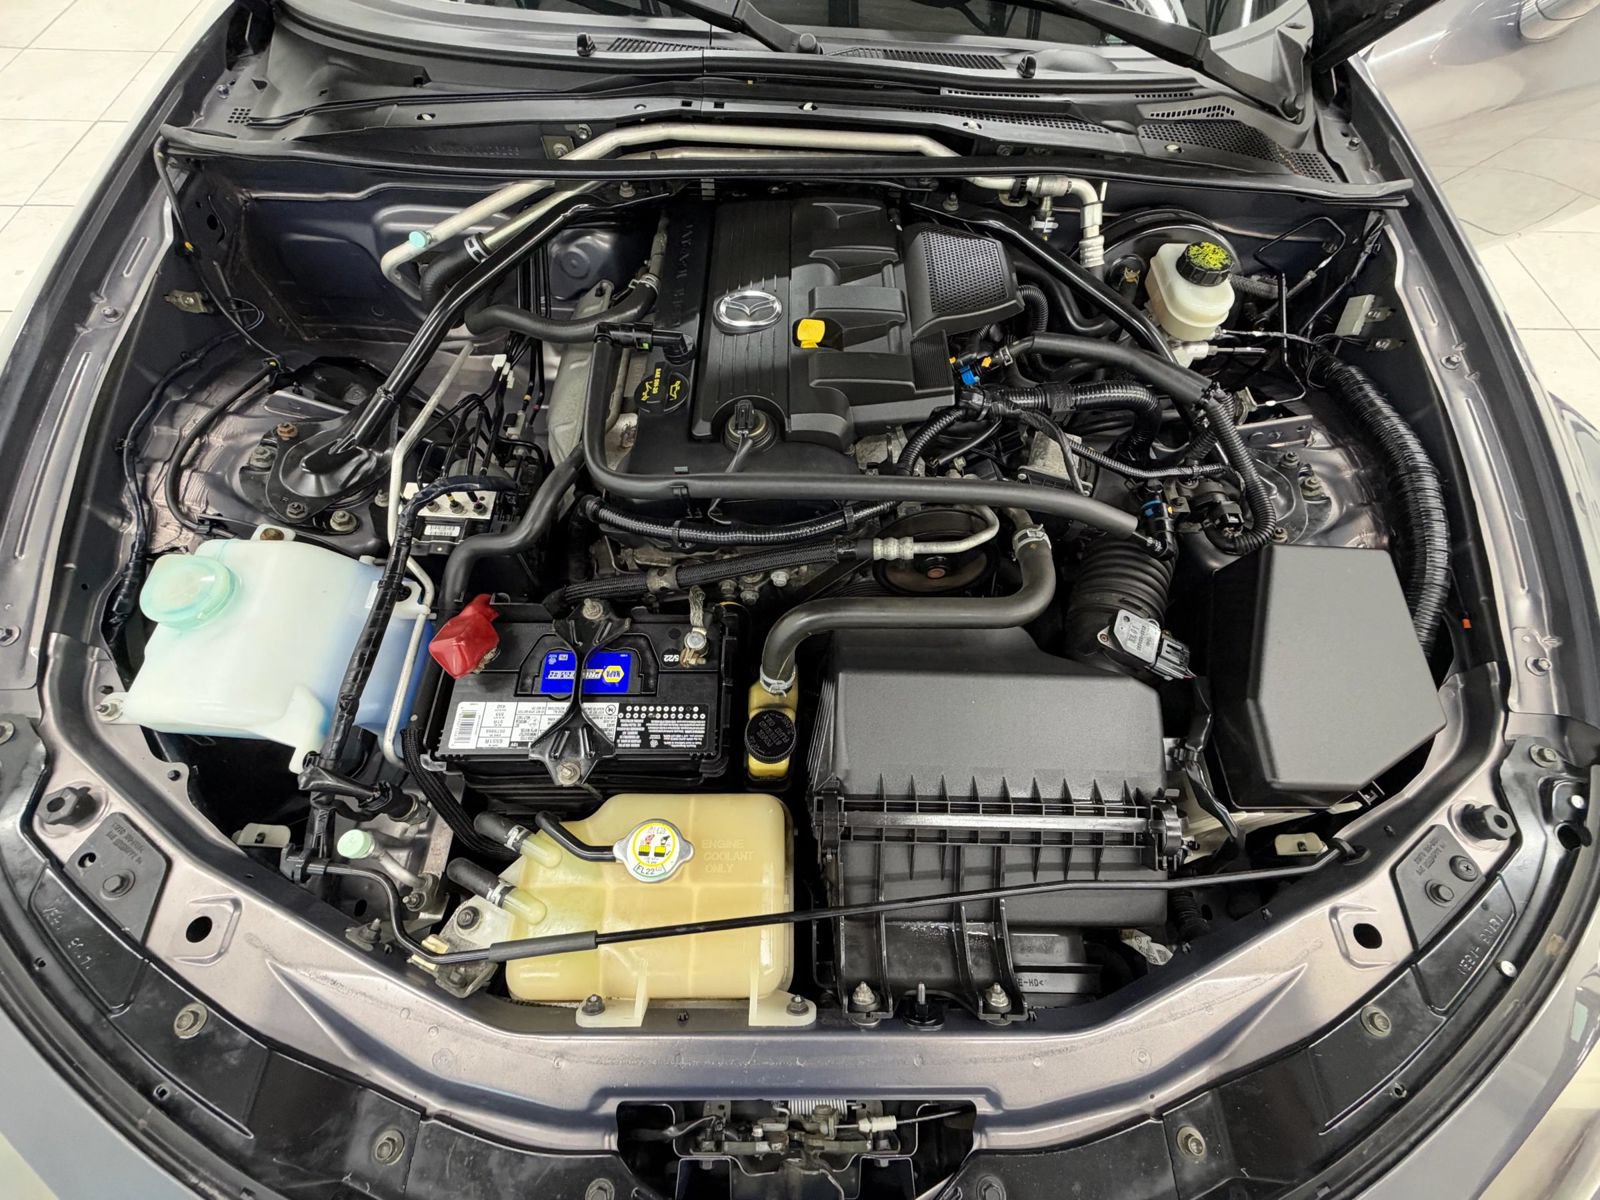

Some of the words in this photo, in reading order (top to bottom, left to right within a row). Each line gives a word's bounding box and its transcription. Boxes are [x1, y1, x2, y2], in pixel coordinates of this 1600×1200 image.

[663, 654, 680, 662] 5/22
[605, 669, 621, 679] NAPA
[702, 839, 744, 849] ENGINE
[703, 851, 753, 861] COOLANT
[636, 864, 656, 875] FL22
[705, 863, 735, 873] ONLY
